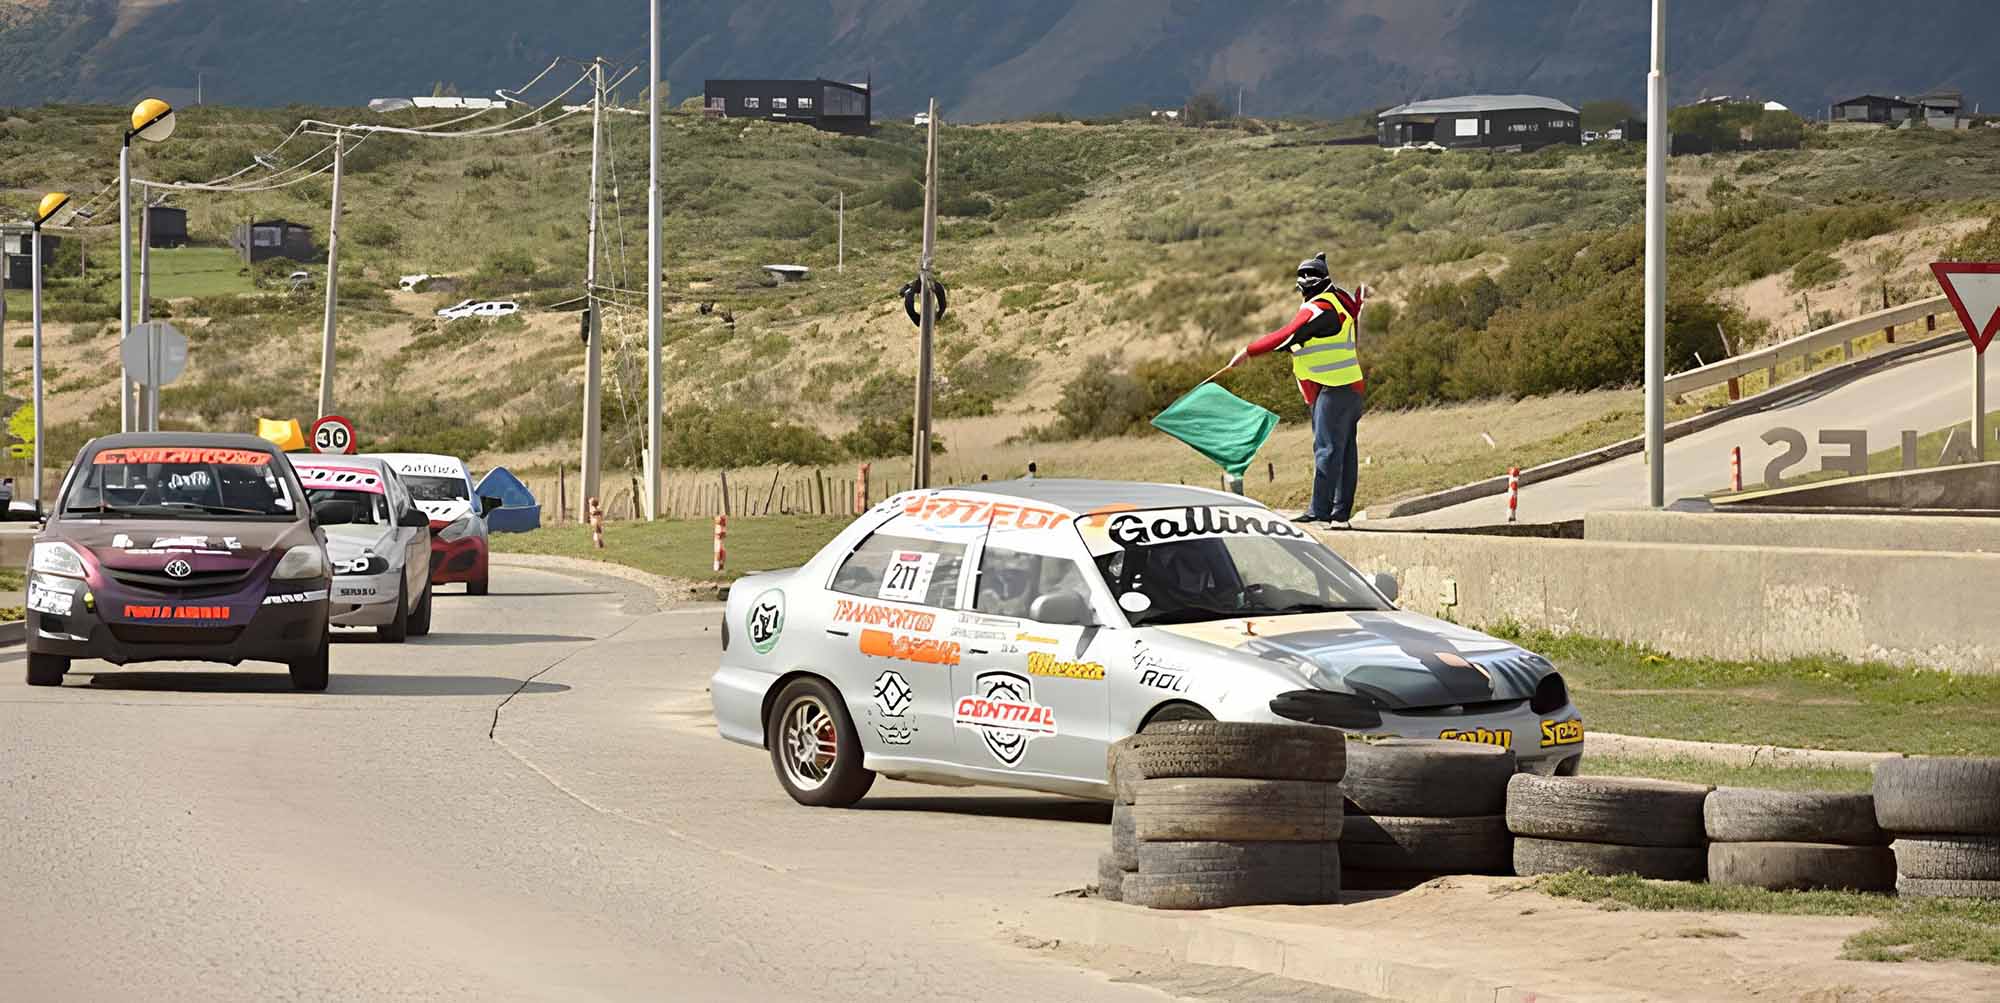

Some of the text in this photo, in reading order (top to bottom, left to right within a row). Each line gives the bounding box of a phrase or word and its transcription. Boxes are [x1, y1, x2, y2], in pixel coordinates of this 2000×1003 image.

[317, 428, 348, 448] 30
[1108, 506, 1304, 546] Gallina
[887, 563, 920, 591] 211
[958, 698, 1054, 725] CENTRAL
